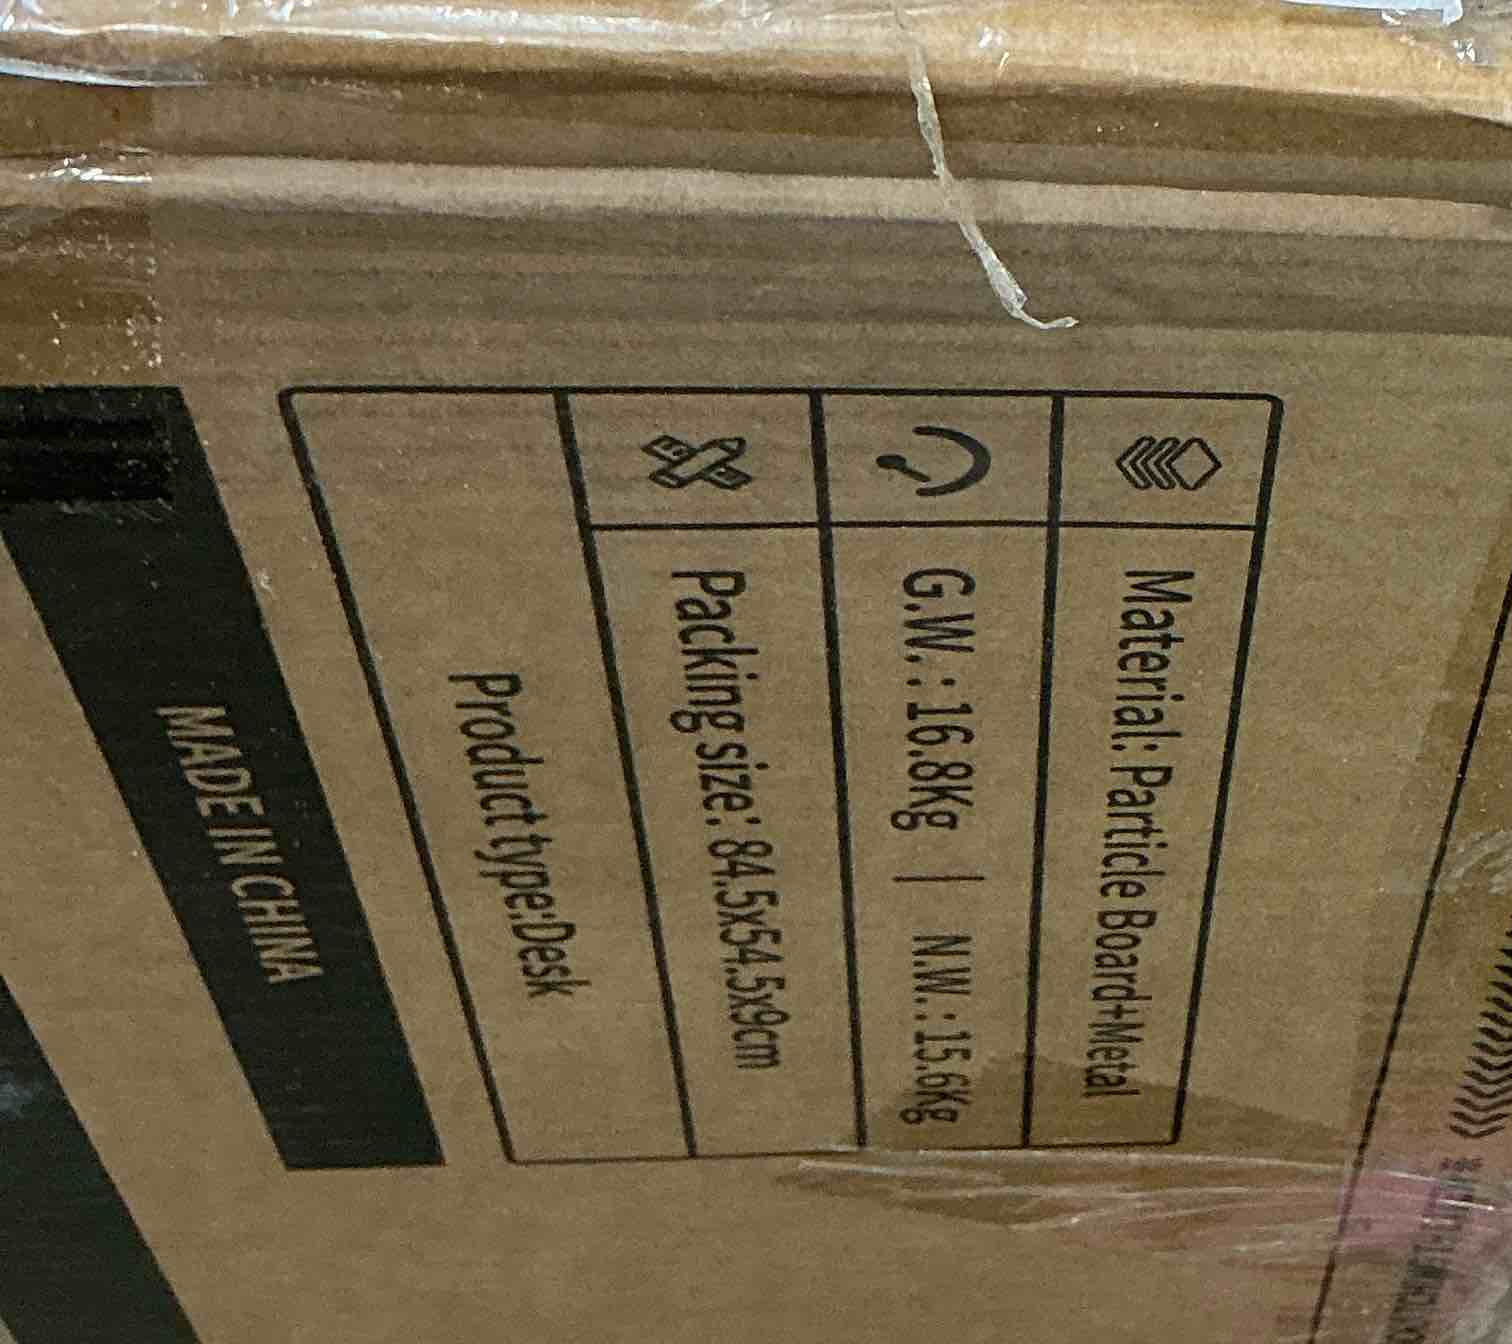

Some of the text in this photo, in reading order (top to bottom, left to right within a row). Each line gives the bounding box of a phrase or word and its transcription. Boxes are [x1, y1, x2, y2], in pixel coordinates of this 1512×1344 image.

[155, 705, 324, 985] MADE IN CHINA
[448, 673, 548, 826] Product
[670, 569, 790, 1069] Packing size: 84.5x54.5x9cm
[890, 700, 976, 832] 16.8Kg
[1082, 567, 1195, 1099] Material: Particle Board+Metal
[899, 1030, 972, 1124] 15.6Kg
